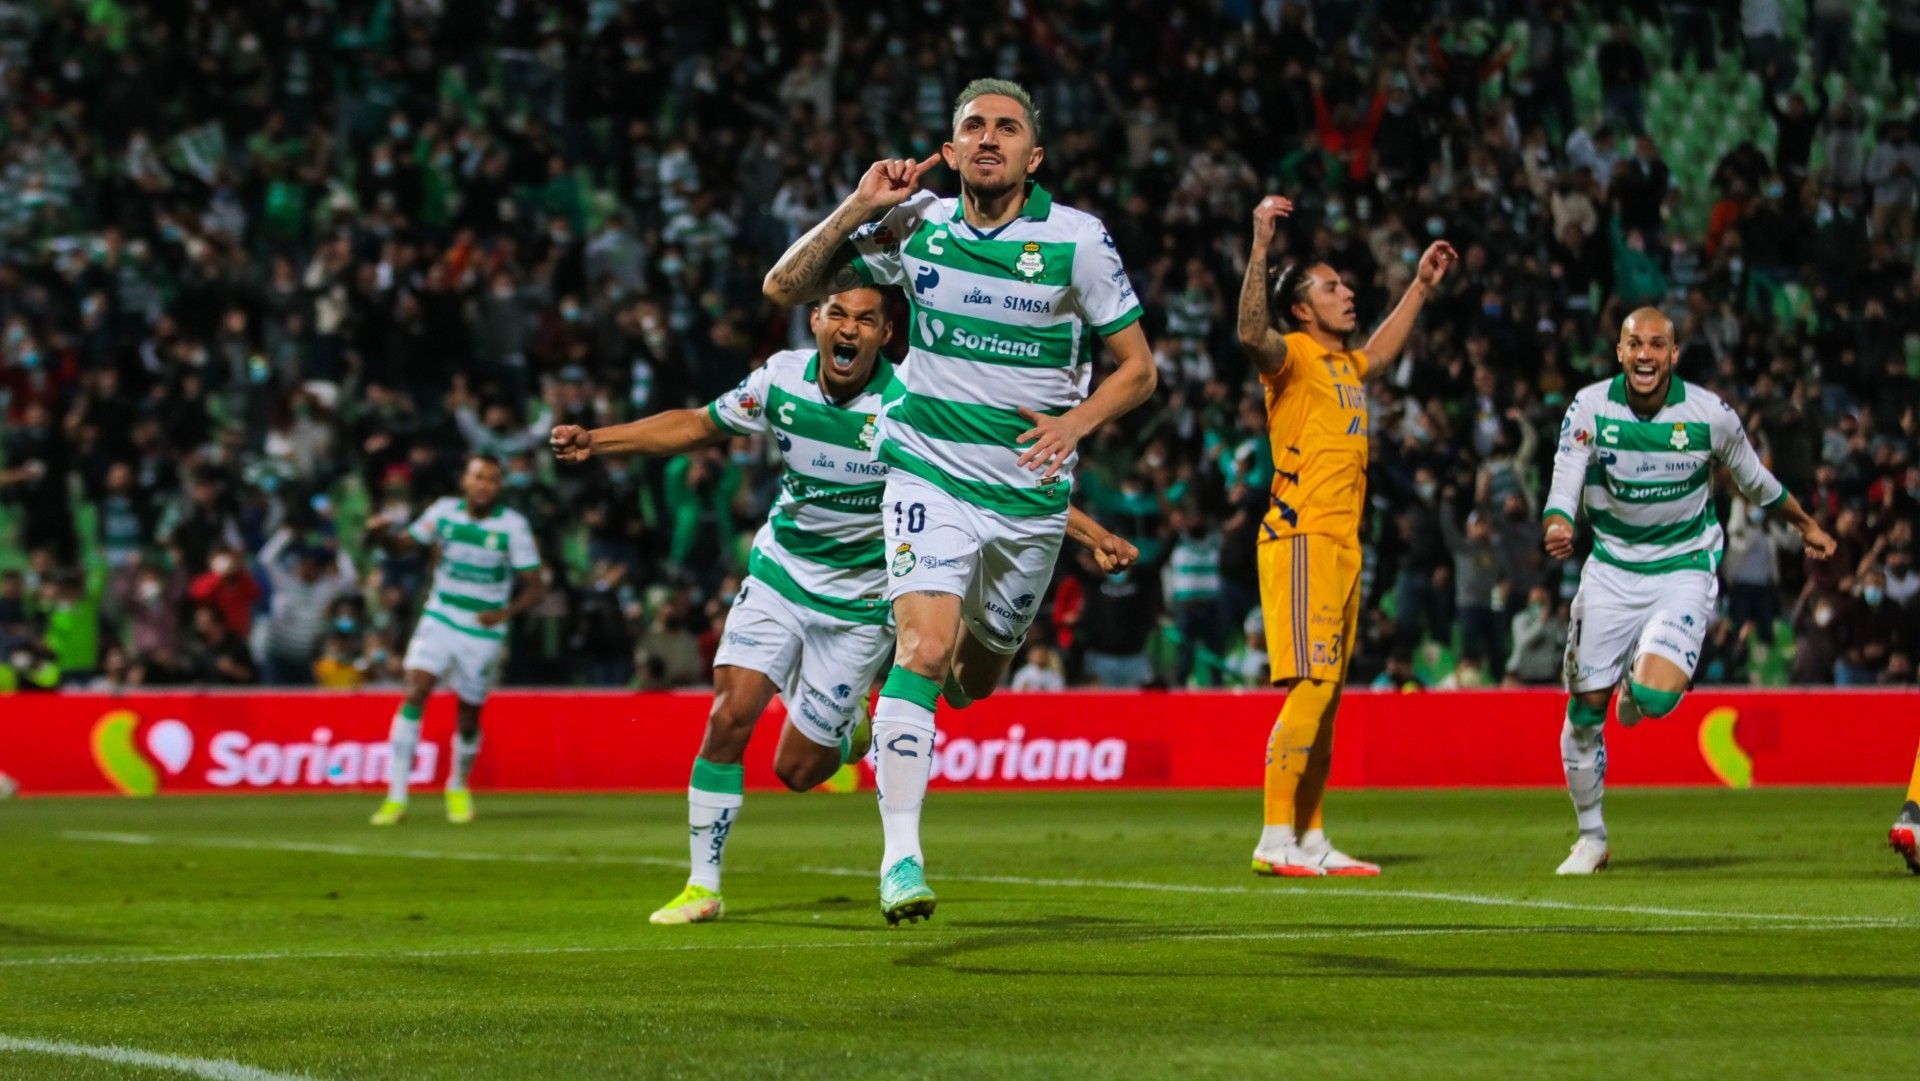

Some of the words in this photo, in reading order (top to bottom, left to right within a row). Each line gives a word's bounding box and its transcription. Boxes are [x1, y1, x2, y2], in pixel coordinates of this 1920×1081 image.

[1003, 295, 1050, 313] SIMSA
[951, 327, 1040, 357] Soriana
[844, 461, 889, 477] SIMSA
[1665, 461, 1698, 472] SIMSA
[894, 501, 927, 536] 10
[705, 808, 732, 865] IMSA
